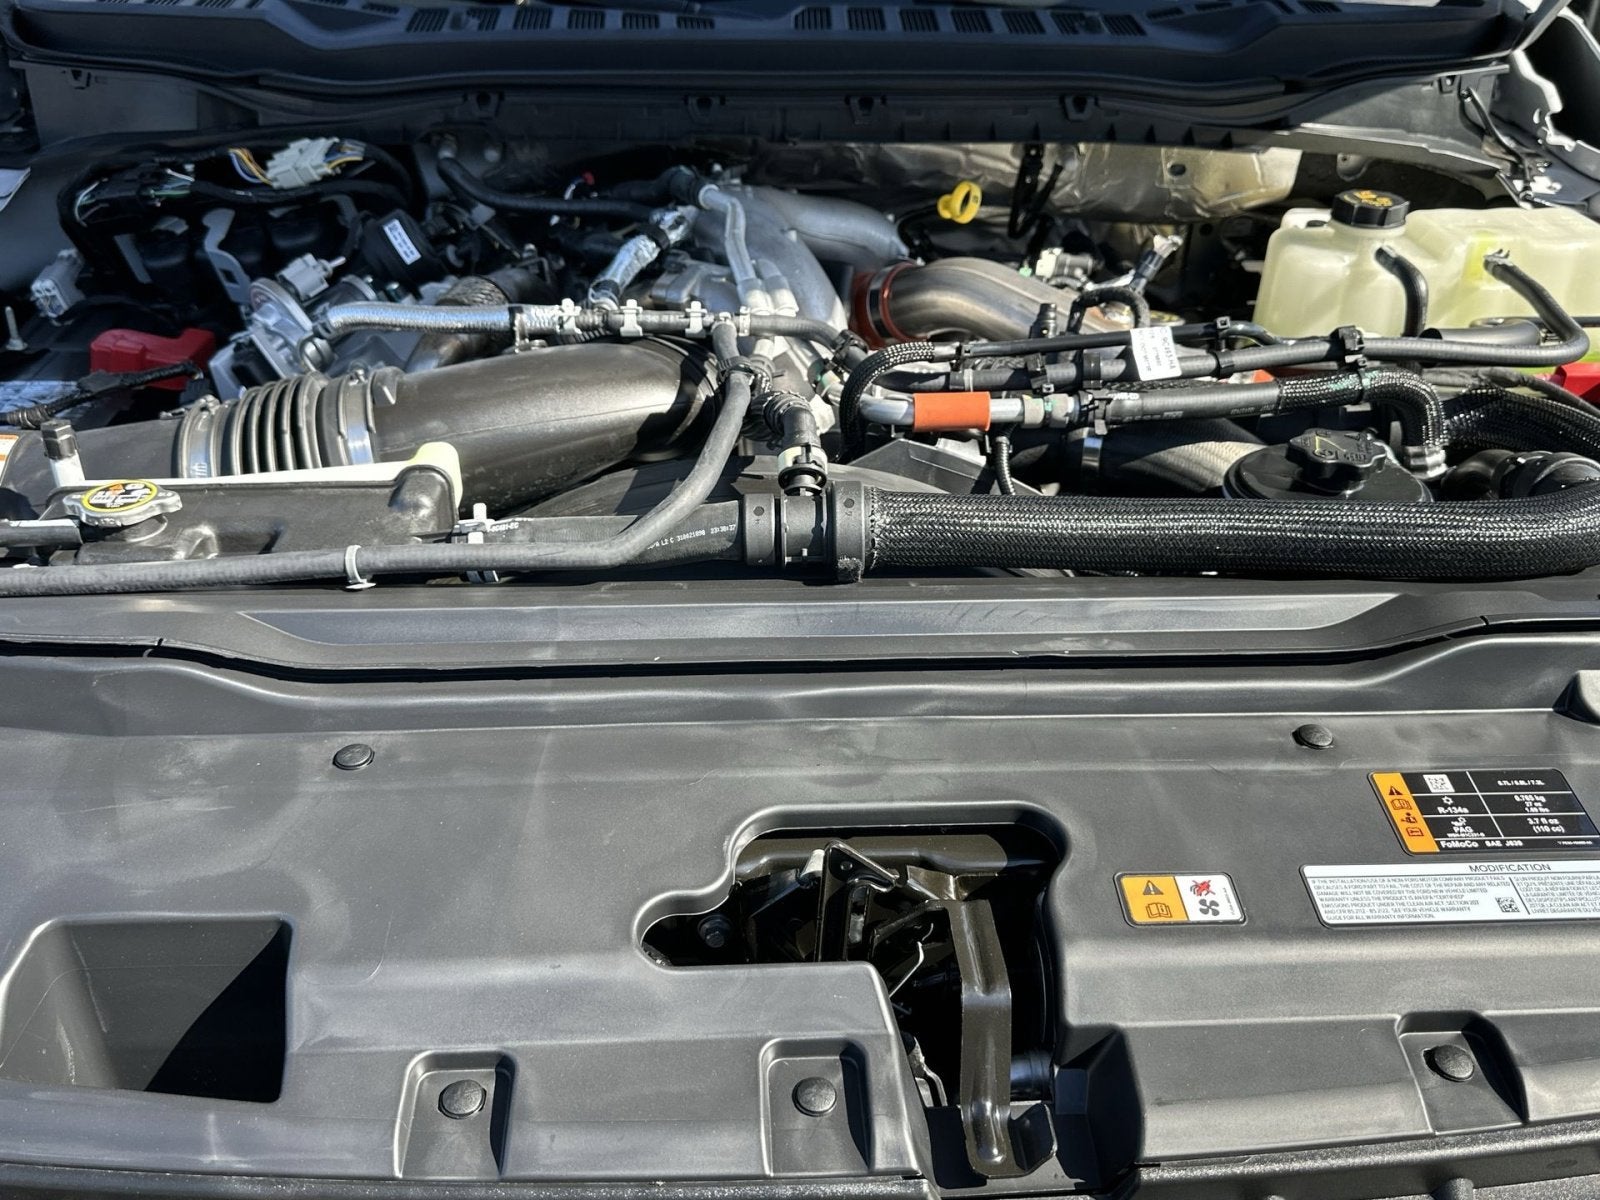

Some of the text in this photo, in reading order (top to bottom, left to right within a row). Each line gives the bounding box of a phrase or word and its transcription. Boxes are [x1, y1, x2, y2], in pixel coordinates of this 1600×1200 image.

[1437, 806, 1470, 814] R-134a
[1532, 824, 1566, 834] (110 cc)
[1440, 840, 1480, 848] FoMoCo
[1468, 864, 1552, 872] MODIFICATION
